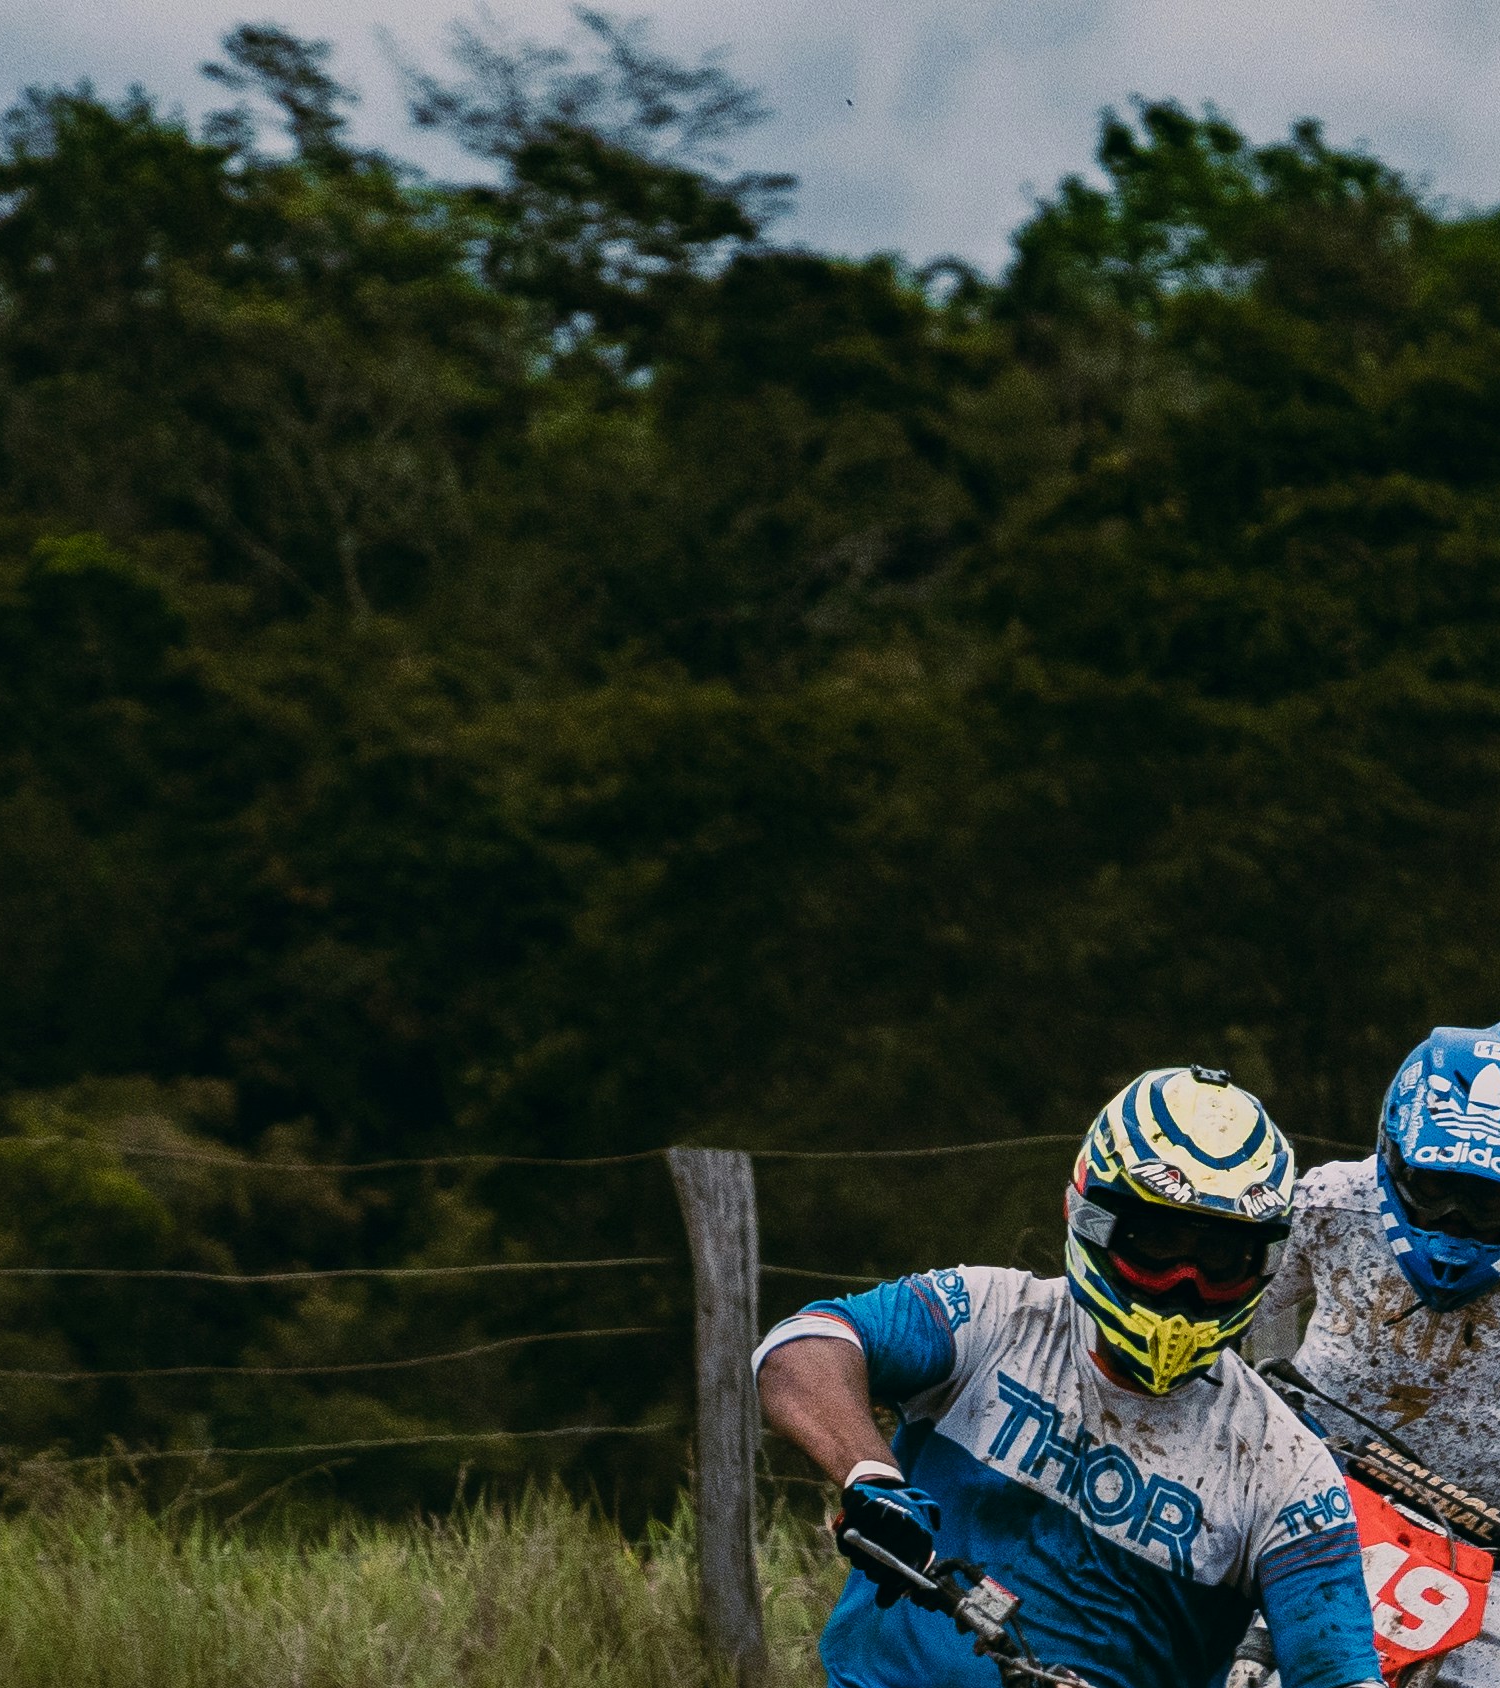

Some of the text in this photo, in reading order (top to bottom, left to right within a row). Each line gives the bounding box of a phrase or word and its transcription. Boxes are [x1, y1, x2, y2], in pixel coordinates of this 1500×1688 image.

[934, 1269, 971, 1333] OR
[996, 1369, 1203, 1578] THOR
[1274, 1485, 1352, 1538] THO
